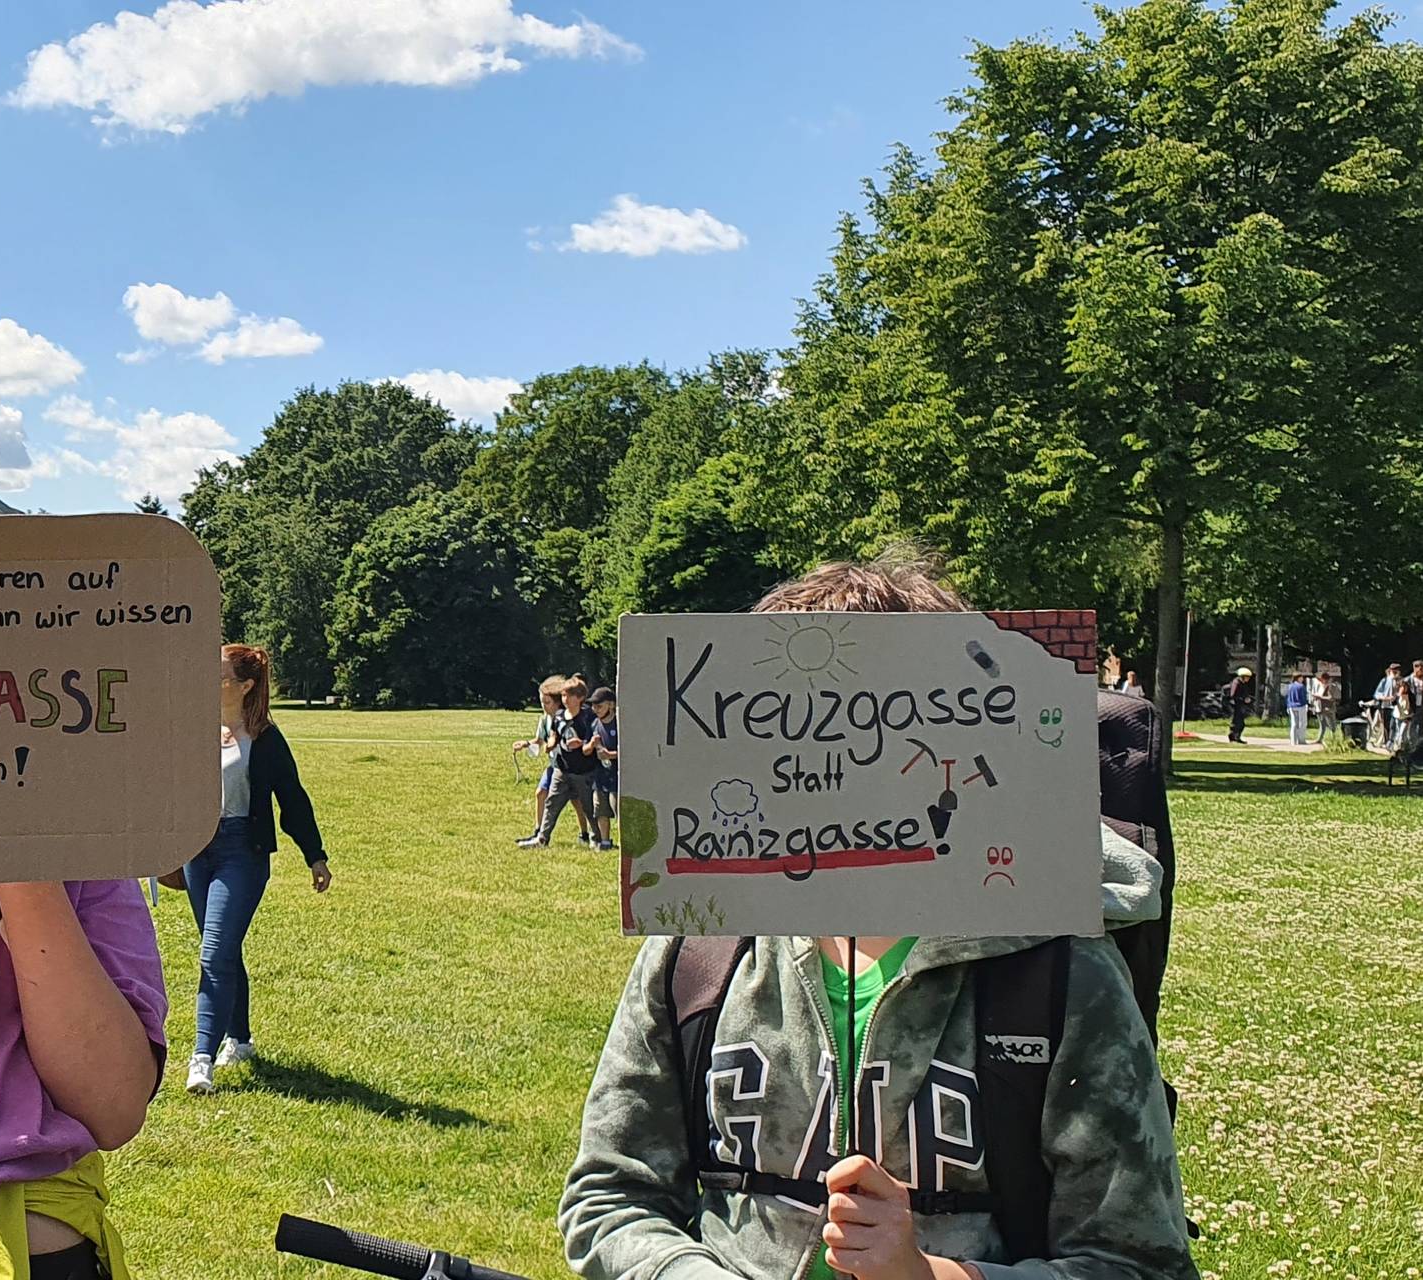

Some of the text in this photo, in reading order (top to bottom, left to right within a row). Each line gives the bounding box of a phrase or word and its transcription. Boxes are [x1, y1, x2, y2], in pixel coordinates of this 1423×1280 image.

[67, 562, 120, 591] auf
[36, 604, 81, 630] wir
[95, 600, 192, 627] wissen
[665, 637, 1017, 766] Kreuzgasse
[671, 804, 952, 881] Ranzgasse!
